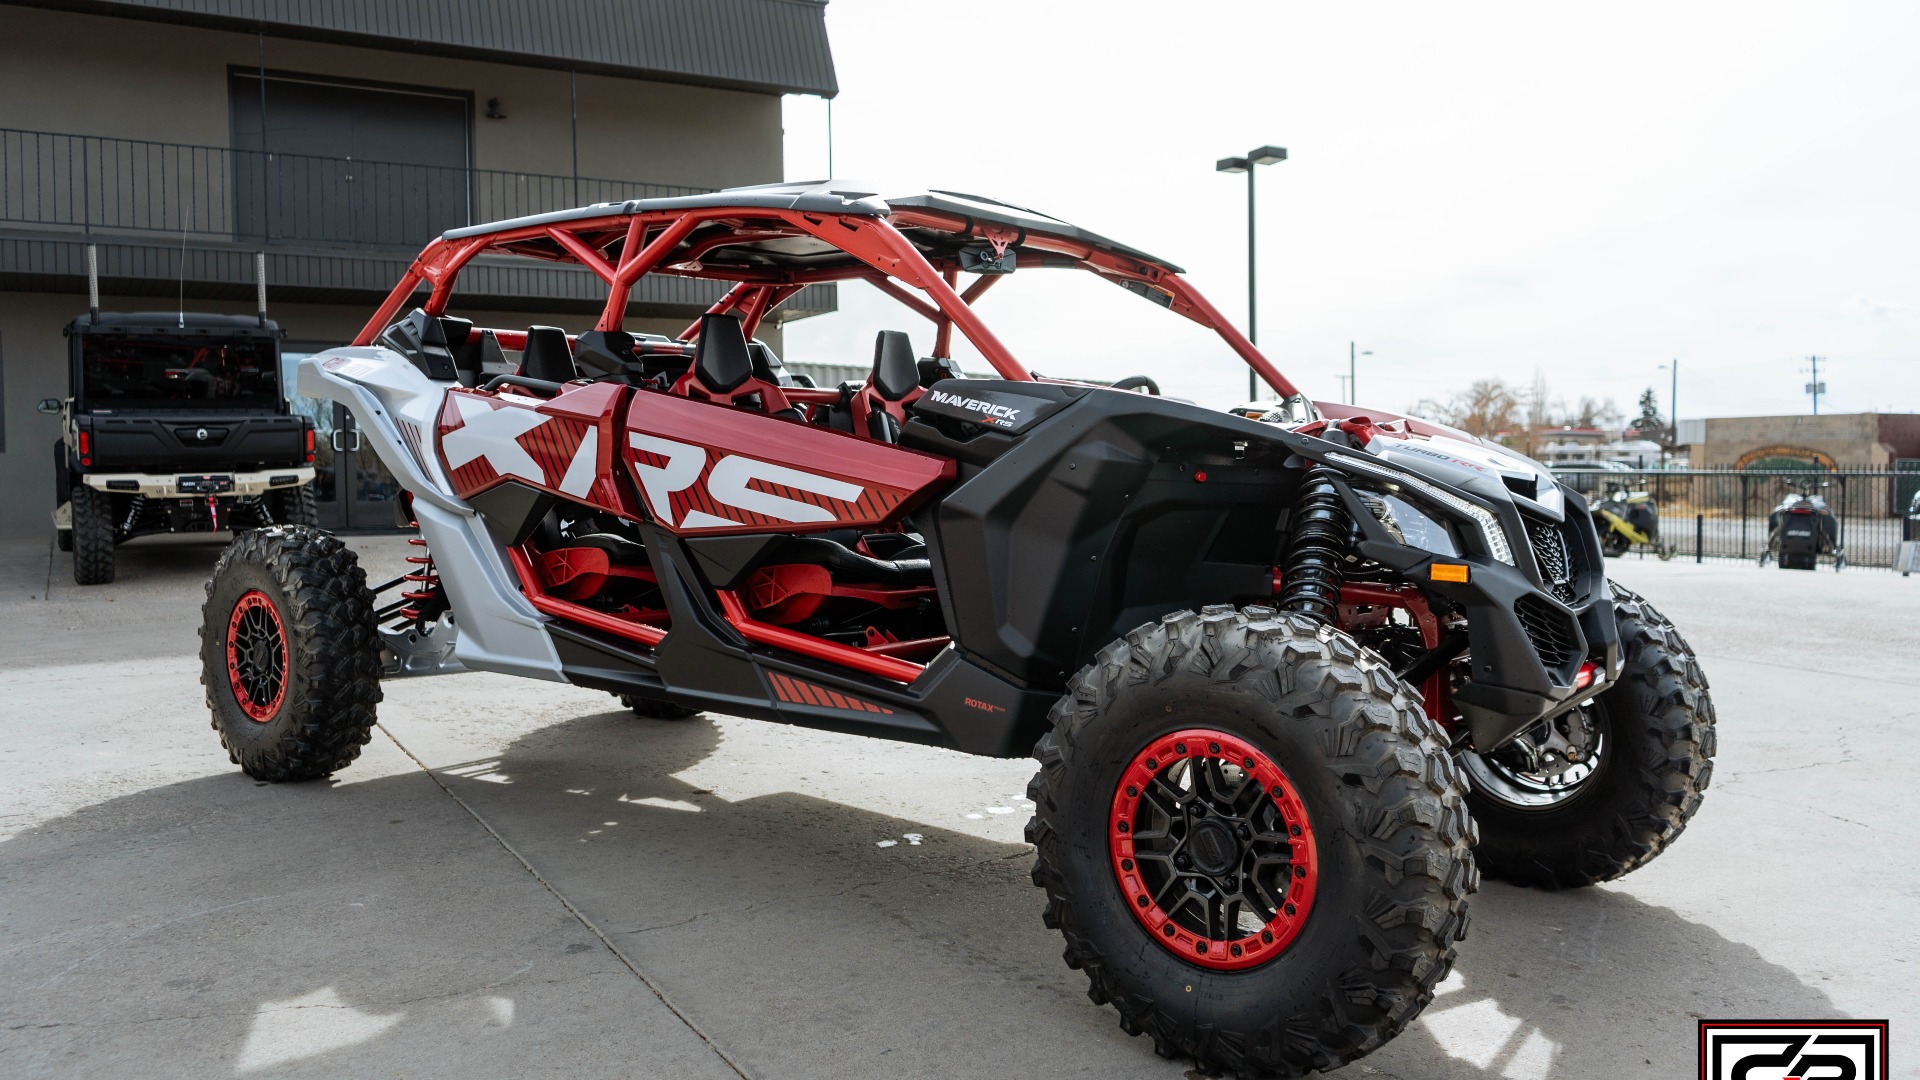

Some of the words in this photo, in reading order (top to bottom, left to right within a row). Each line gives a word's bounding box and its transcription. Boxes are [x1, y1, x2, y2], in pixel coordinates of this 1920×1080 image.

[930, 390, 1021, 421] MAVERICK
[1395, 443, 1451, 460] TURBO
[964, 697, 994, 713] ROTAX
